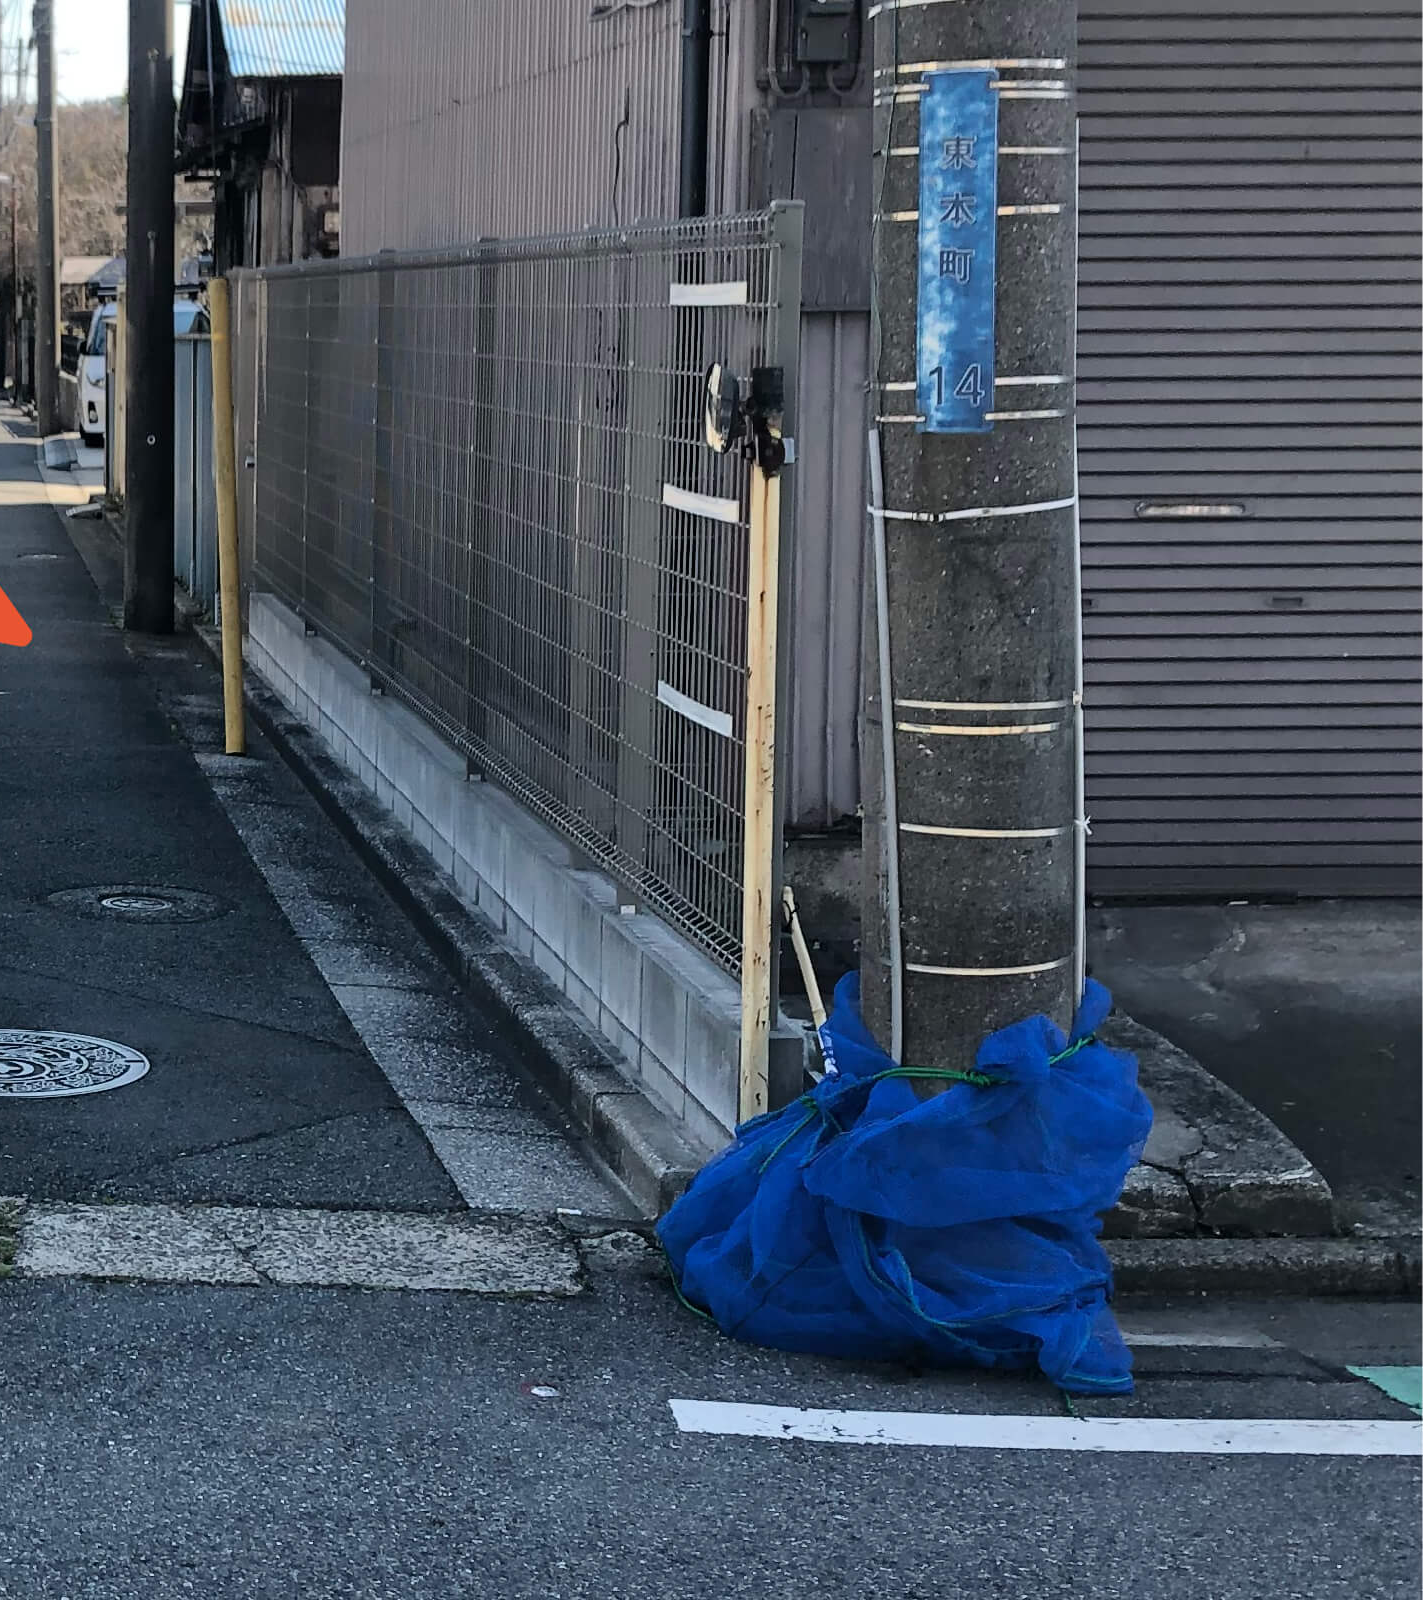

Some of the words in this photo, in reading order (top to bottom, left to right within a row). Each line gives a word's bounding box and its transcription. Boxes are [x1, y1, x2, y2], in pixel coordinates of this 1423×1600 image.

[938, 136, 977, 284] 東本町
[928, 362, 986, 409] 14
